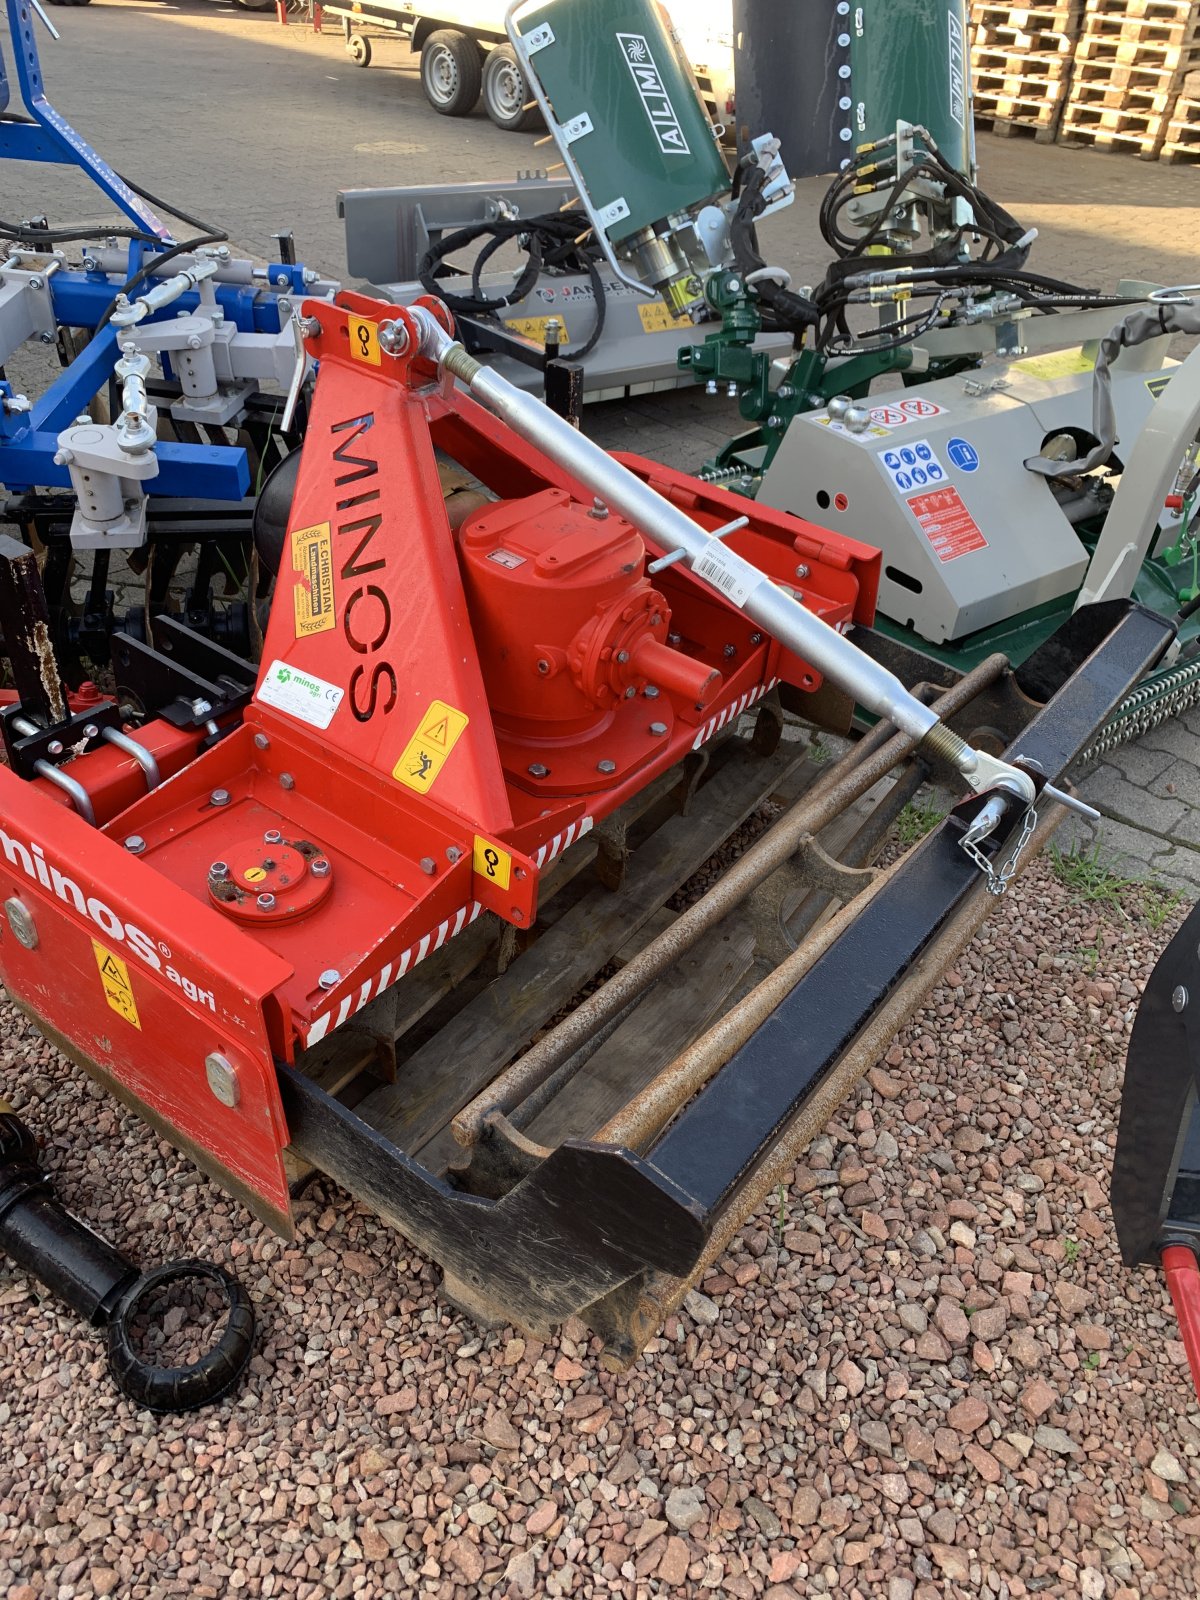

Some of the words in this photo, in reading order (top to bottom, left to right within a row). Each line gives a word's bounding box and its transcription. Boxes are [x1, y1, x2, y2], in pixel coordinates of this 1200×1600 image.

[310, 545, 319, 614] Landmaschinen
[331, 412, 397, 723] MINOS
[293, 675, 320, 692] minos
[309, 690, 321, 698] agri
[326, 690, 339, 702] CE
[165, 965, 216, 1012] agri
